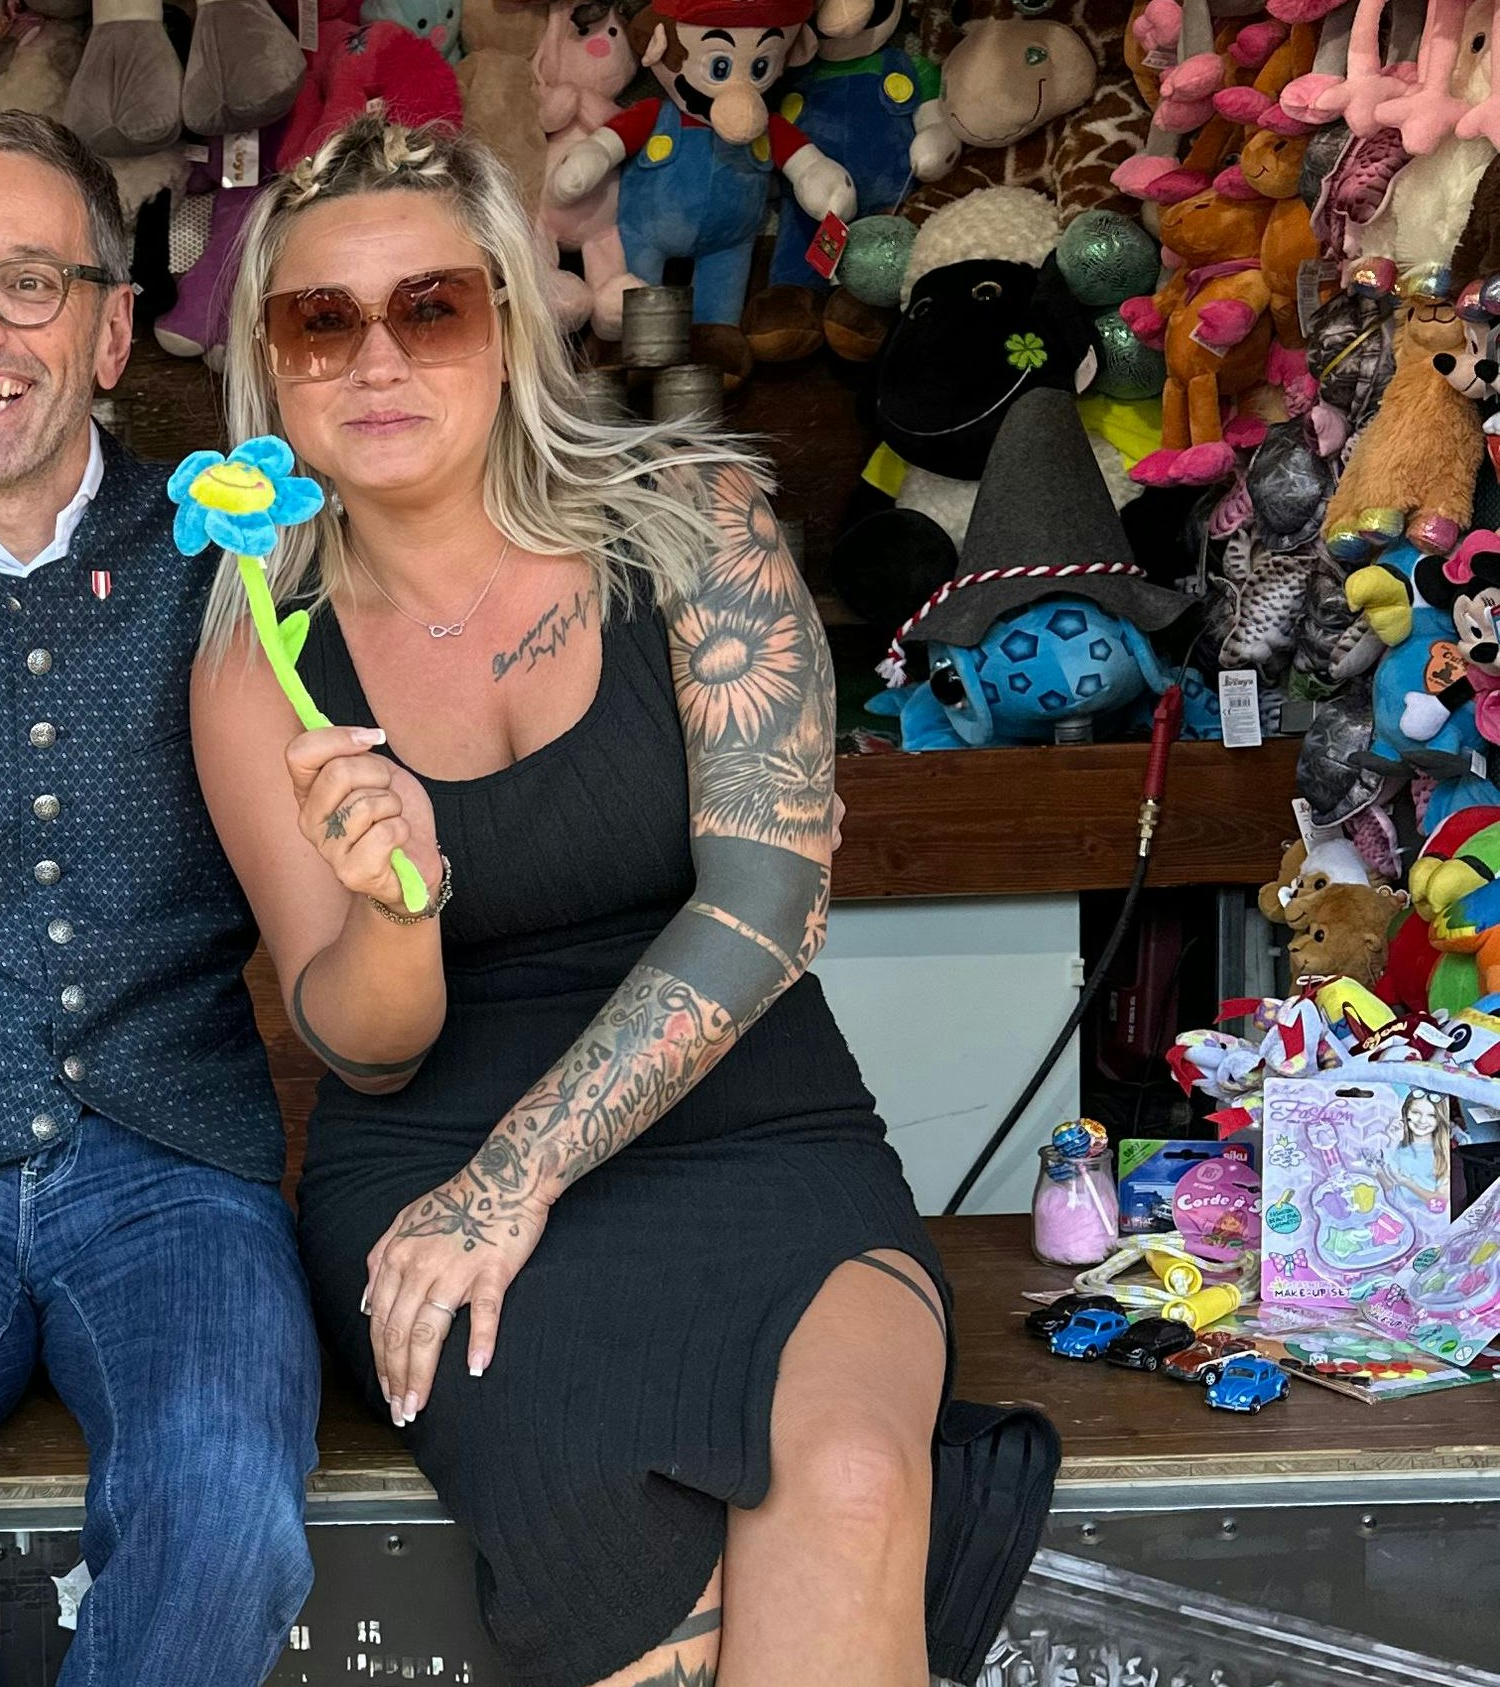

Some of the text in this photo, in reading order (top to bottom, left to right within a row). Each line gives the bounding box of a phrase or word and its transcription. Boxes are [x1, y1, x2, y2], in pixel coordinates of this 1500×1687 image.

[1223, 1150, 1248, 1161] siku
[1177, 1193, 1230, 1211] Corde
[1248, 1198, 1262, 1213] S
[1274, 1287, 1352, 1298] MAKE-UP SET
